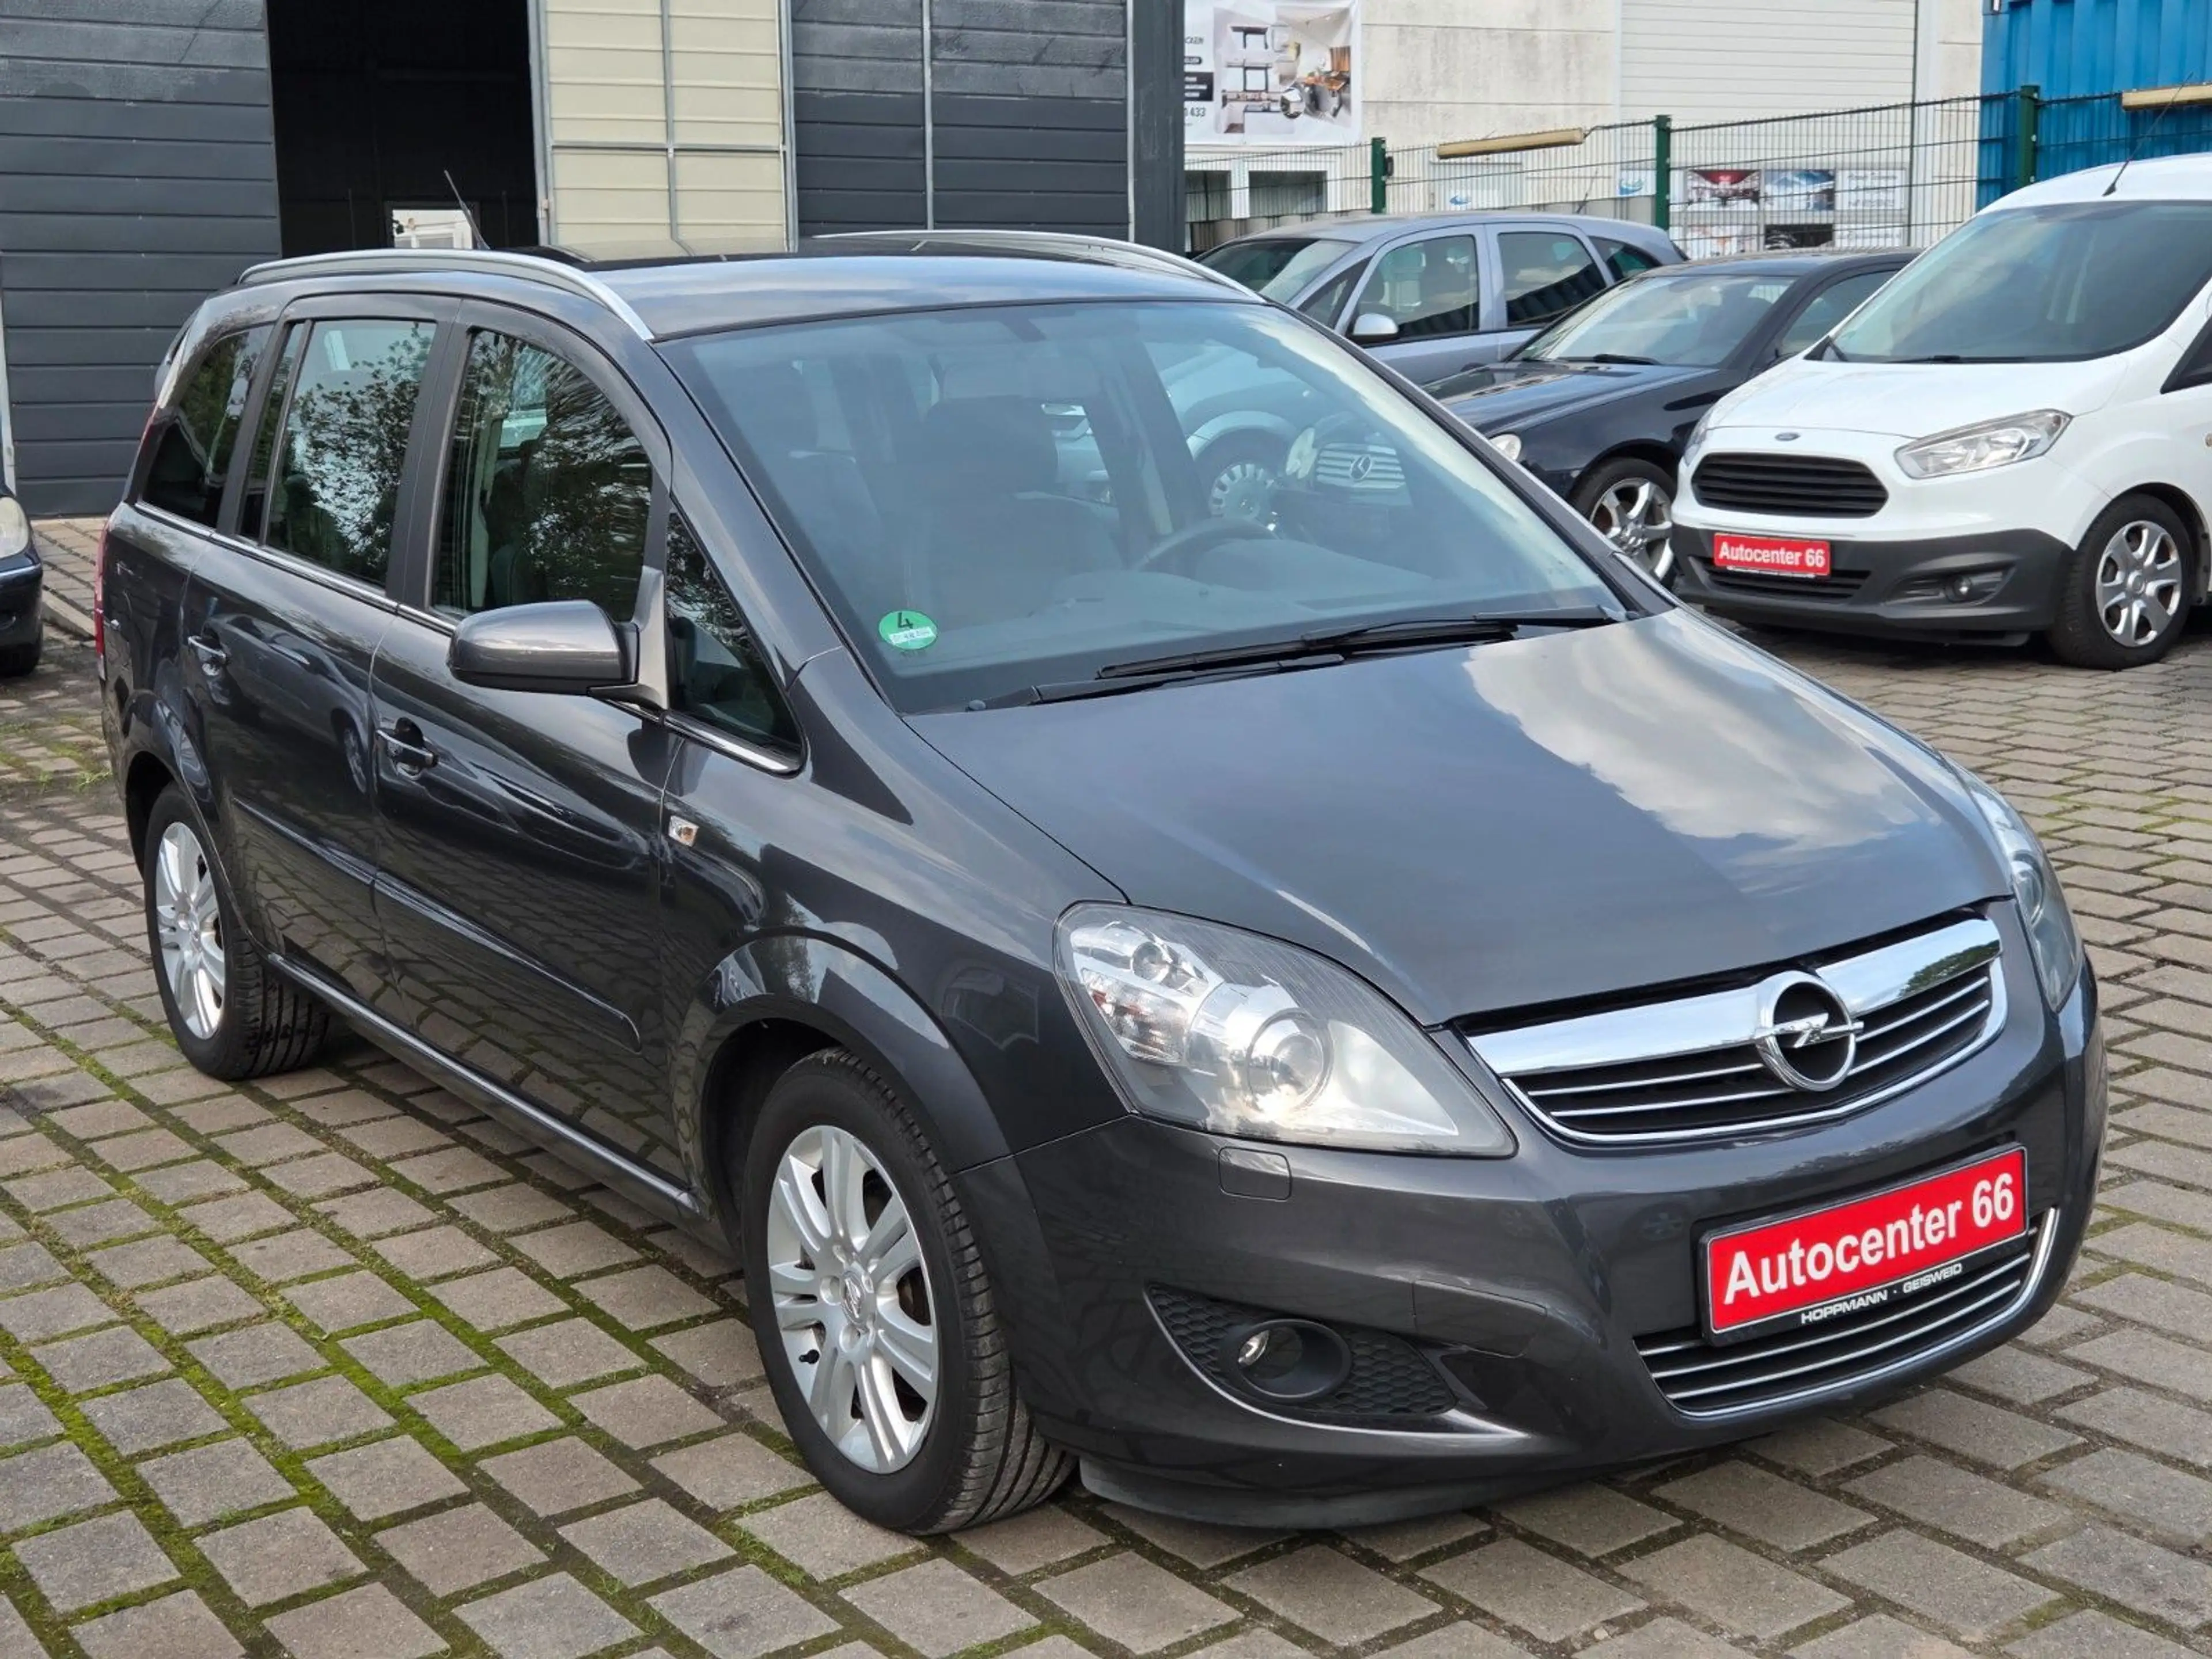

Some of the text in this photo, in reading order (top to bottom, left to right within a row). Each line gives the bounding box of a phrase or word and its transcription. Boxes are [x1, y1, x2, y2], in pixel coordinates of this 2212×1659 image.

[1719, 541, 1825, 567] Autocenter 66
[897, 612, 914, 629] 4
[1724, 1173, 2014, 1305] Autocenter 66
[1801, 1263, 1963, 1324] HOPPMANN GEISWEID
